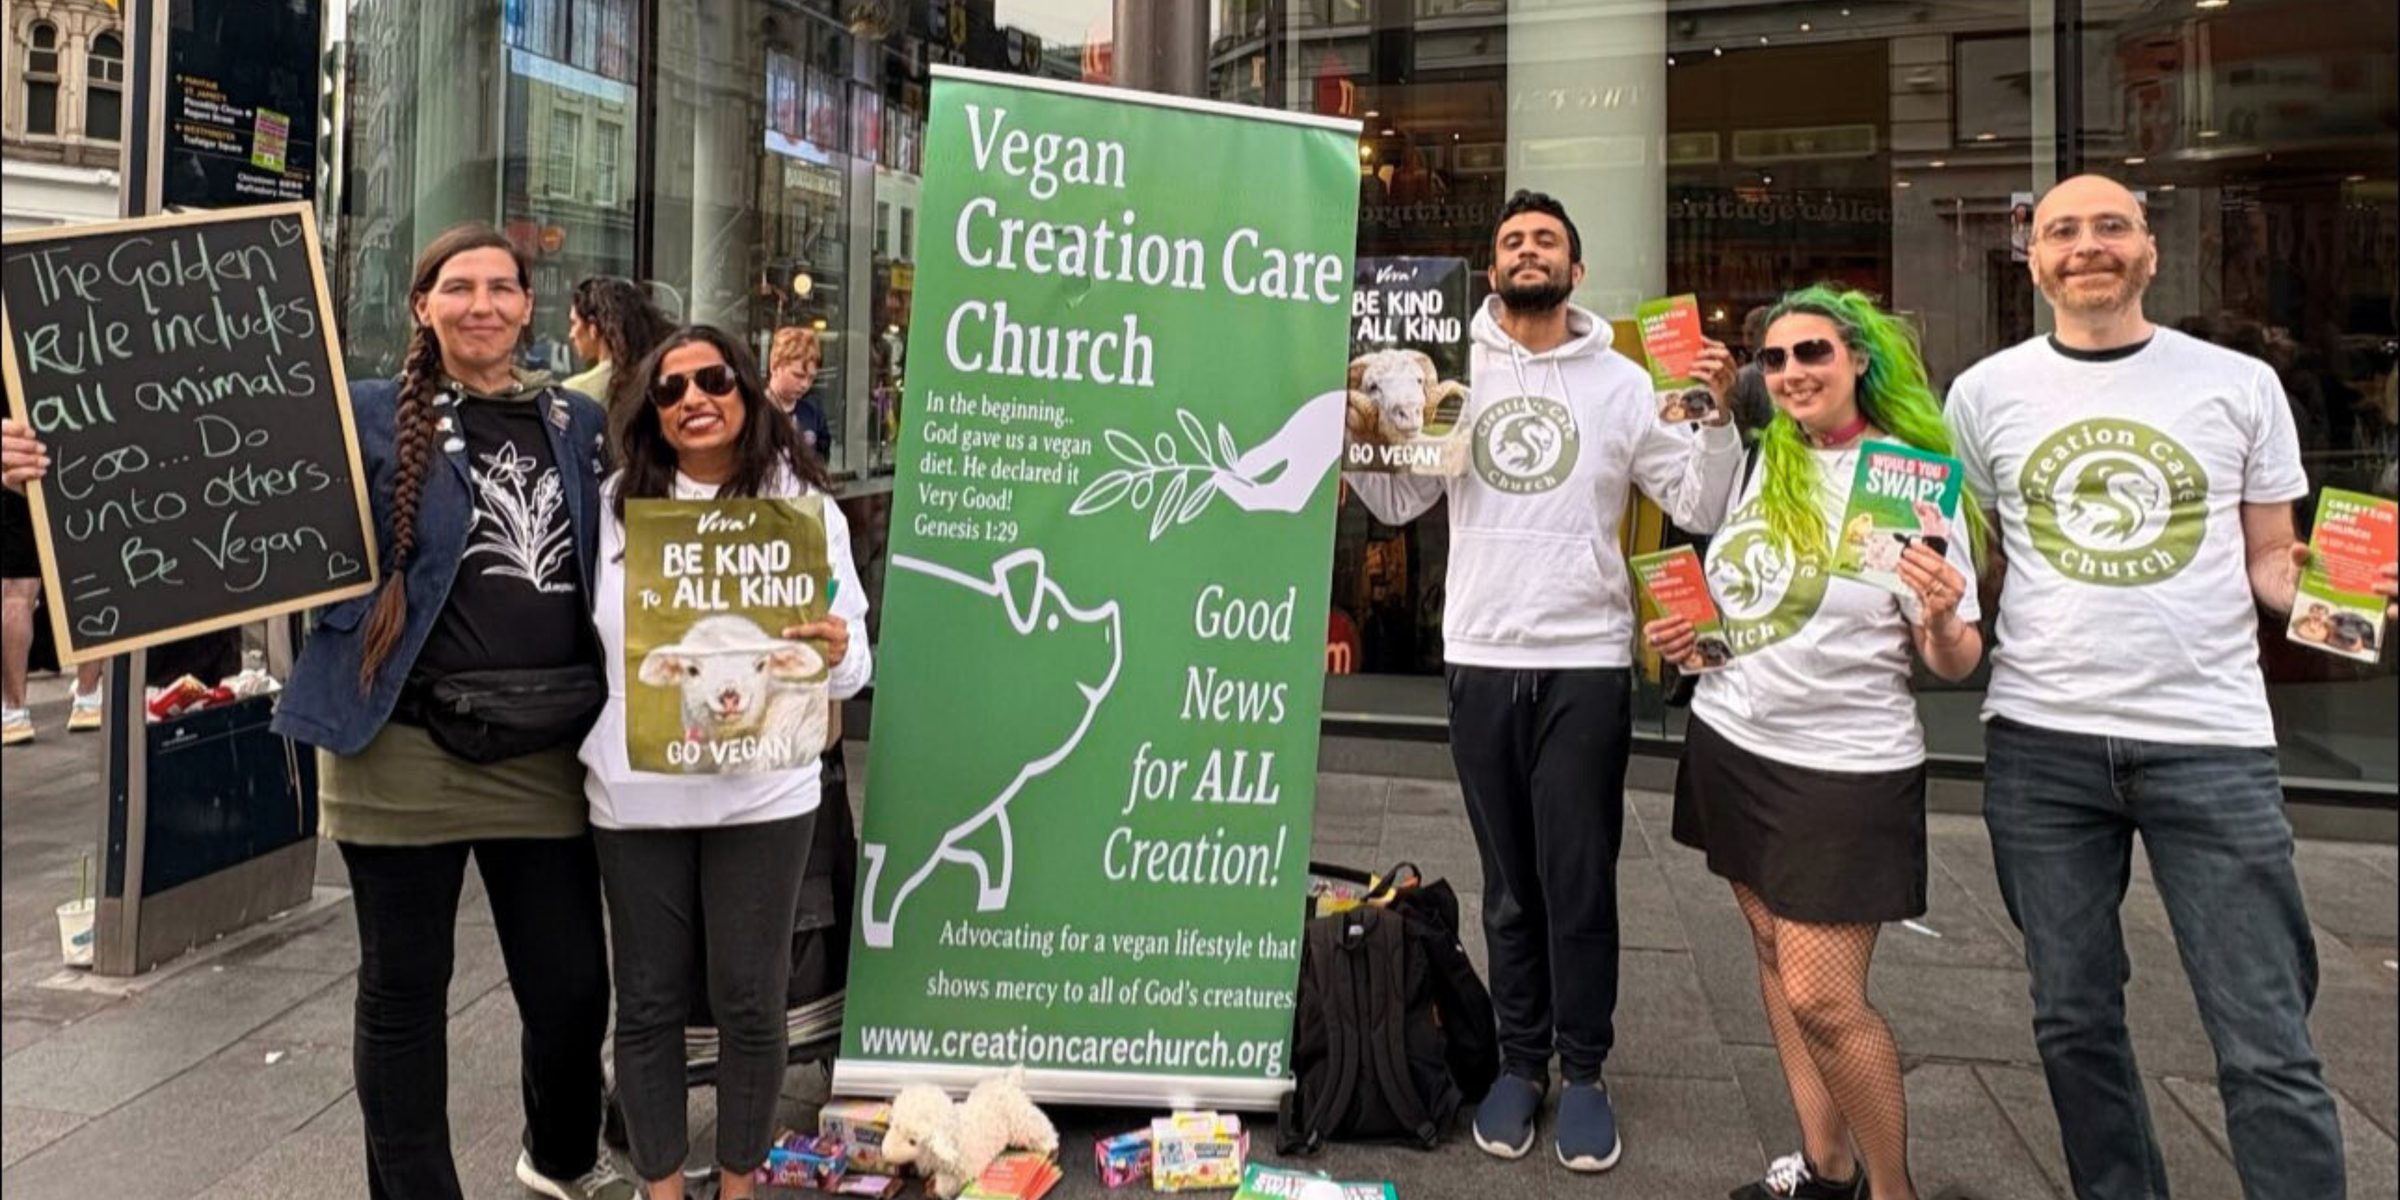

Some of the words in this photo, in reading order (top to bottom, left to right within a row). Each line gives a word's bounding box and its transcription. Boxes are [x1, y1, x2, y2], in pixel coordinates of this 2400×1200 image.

[964, 104, 1127, 200] Vegan
[955, 197, 1206, 290] Creation
[1222, 228, 1344, 304] Care
[6, 246, 102, 307] The
[107, 231, 278, 315] Golden
[1352, 290, 1380, 316] BE
[1388, 288, 1444, 316] KIND
[25, 304, 133, 375] Rule
[152, 285, 315, 356] includes
[945, 300, 1155, 388] Church
[1357, 316, 1398, 342] ALL
[31, 382, 117, 432] all
[135, 354, 315, 413] animals
[926, 390, 944, 413] In
[950, 391, 977, 415] the
[981, 394, 1074, 430] beginning..
[193, 414, 269, 458] Do
[923, 420, 958, 445] God
[961, 429, 1001, 451] gave
[1006, 432, 1024, 450] us
[1028, 435, 1038, 451] a
[1043, 437, 1092, 460] vegan
[1349, 443, 1374, 464] GO
[1379, 444, 1442, 466] VEGAN
[920, 452, 957, 476] diet.
[963, 455, 986, 478] He
[991, 456, 1063, 485] declared
[1067, 463, 1080, 486] it
[1487, 470, 1557, 491] Church
[1872, 453, 1917, 474] WOULD
[1918, 462, 1942, 478] YOU
[2026, 425, 2136, 501] Creation
[2149, 440, 2196, 501] Care
[918, 482, 958, 513] Very
[963, 486, 1014, 512] Good!
[1866, 468, 1946, 502] SWAP?
[65, 488, 188, 541] unto
[697, 510, 756, 534] Viva!
[914, 513, 980, 540] Genesis
[985, 520, 1018, 543] 1:29
[120, 537, 185, 589] Be
[192, 511, 329, 593] Vegan
[663, 543, 704, 578] BE
[715, 540, 791, 577] KIND
[2060, 549, 2176, 578] Church
[672, 576, 730, 610] ALL
[1195, 584, 1297, 643] Good
[1180, 666, 1289, 724] News
[666, 740, 700, 766] GO
[709, 735, 793, 766] VEGAN
[1121, 741, 1188, 815] for
[1191, 749, 1280, 804] ALL
[1103, 824, 1288, 887] Creation!
[939, 920, 1055, 958] Advocating
[1059, 924, 1091, 952] for
[1094, 933, 1105, 952] a
[1112, 934, 1169, 962] vegan
[1175, 927, 1253, 965] lifestyle
[1258, 931, 1297, 960] that
[927, 969, 989, 999] shows
[995, 980, 1058, 1008] mercy
[1064, 979, 1083, 1002] to
[1089, 976, 1112, 1004] all
[1119, 977, 1142, 1005] of
[1144, 978, 1198, 1007] God's
[860, 1025, 1285, 1076] www.creationcarechurch.org
